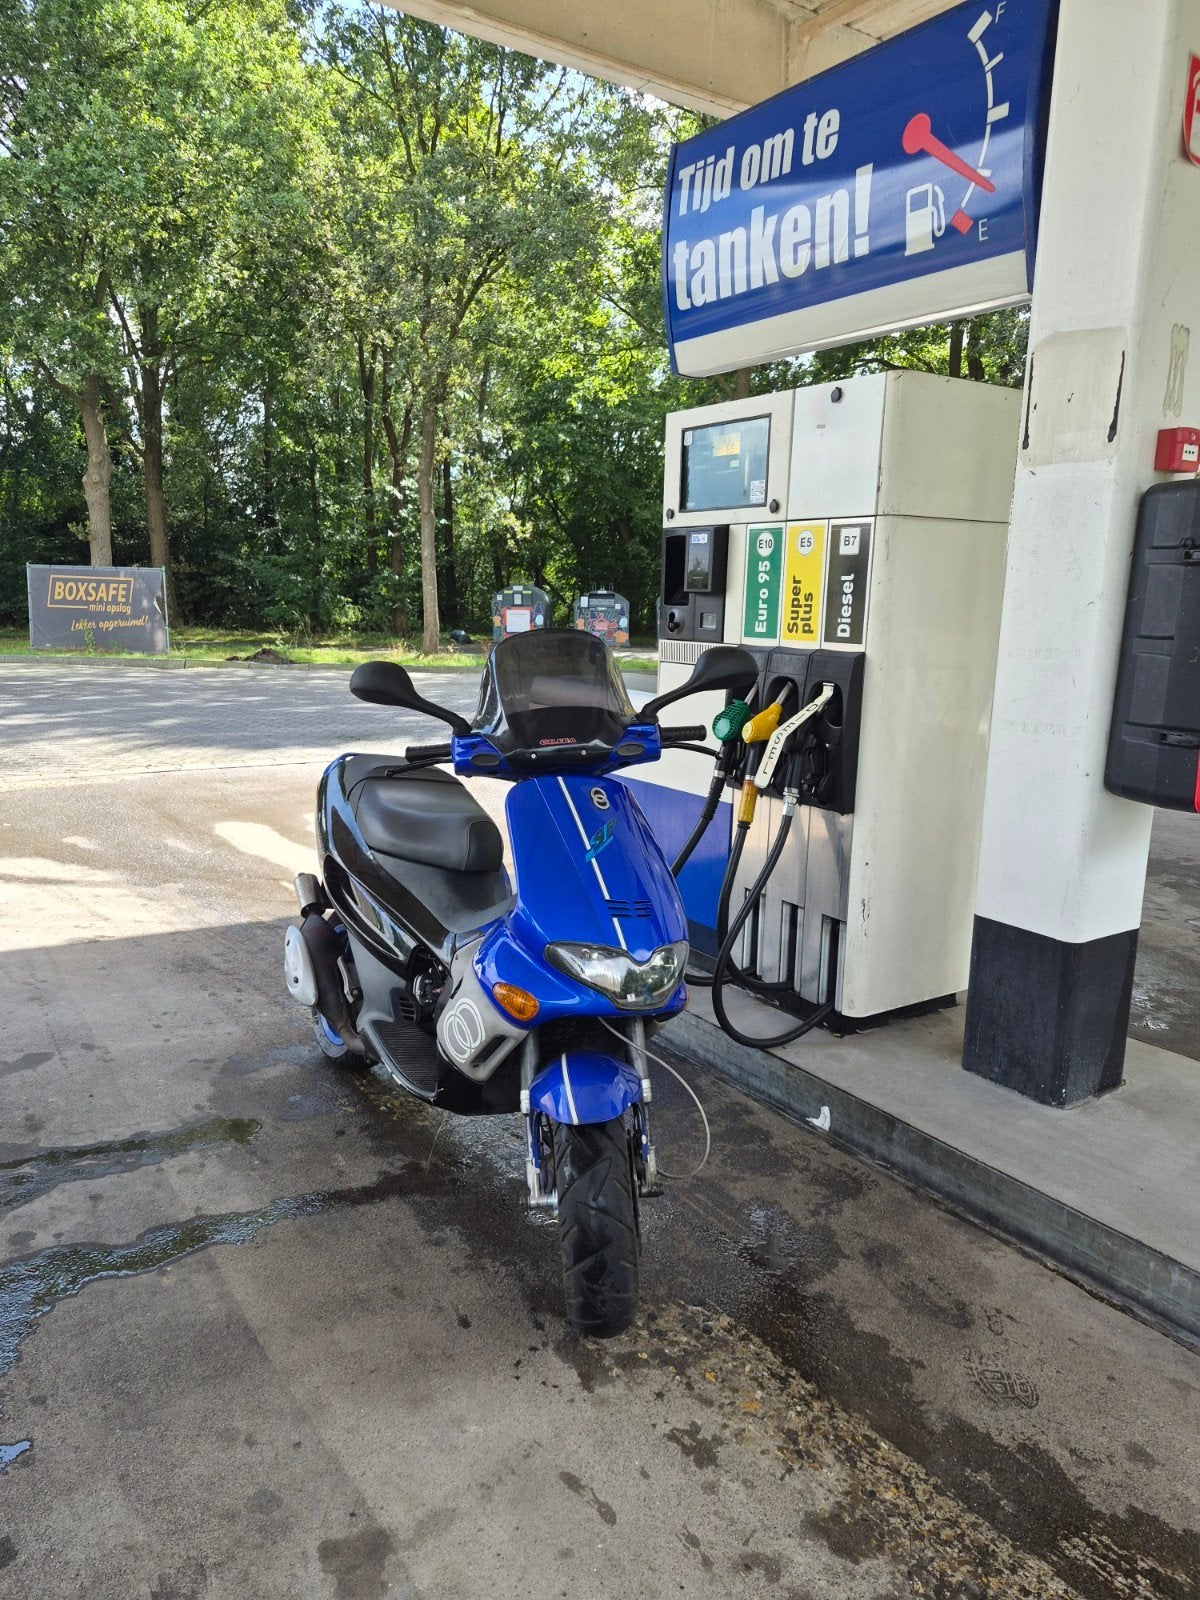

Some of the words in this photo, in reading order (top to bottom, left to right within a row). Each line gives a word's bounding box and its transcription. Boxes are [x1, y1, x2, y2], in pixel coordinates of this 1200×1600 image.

[994, 1, 1007, 24] F
[678, 146, 735, 216] Tijd
[739, 128, 794, 191] om
[801, 108, 840, 166] te
[673, 162, 874, 311] tanken!
[977, 218, 989, 242] E
[758, 539, 773, 549] E10
[800, 537, 812, 548] E5
[843, 535, 857, 546] B7
[758, 560, 770, 583] 95
[54, 582, 127, 602] BOXSAFE
[89, 602, 106, 612] mini
[107, 603, 131, 614] opslag
[754, 588, 769, 633] Euro
[788, 575, 802, 634] Super
[801, 592, 814, 634] plus
[836, 573, 855, 638] Diesel
